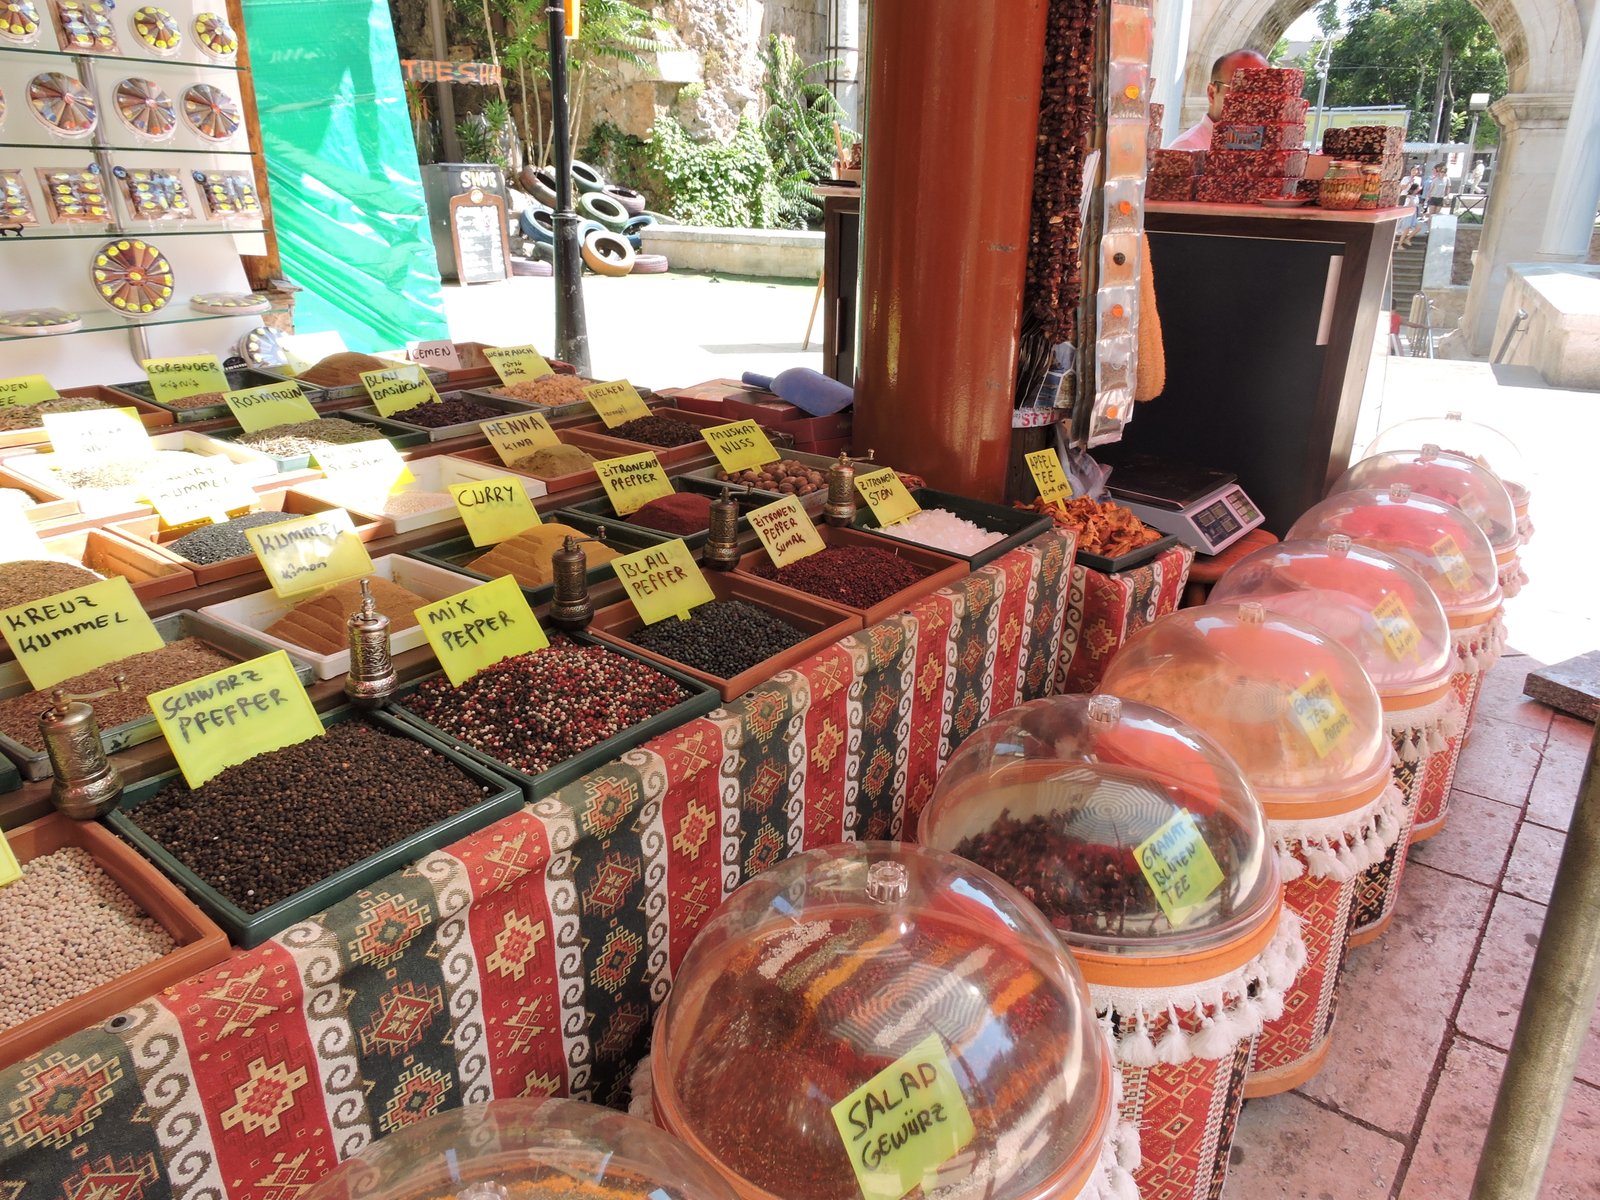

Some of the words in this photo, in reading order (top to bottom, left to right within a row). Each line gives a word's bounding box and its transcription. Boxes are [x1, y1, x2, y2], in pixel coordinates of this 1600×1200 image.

[365, 371, 399, 389] BLAU
[588, 384, 625, 400] NELKEN
[486, 415, 544, 437] HENNA
[710, 425, 756, 441] MUSKAT
[720, 438, 755, 455] NUSS
[1035, 470, 1055, 484] TEE
[458, 486, 513, 507] CURRY
[620, 552, 669, 578] BLAU
[6, 596, 98, 631] KREUZ
[441, 610, 516, 651] PEPPER
[162, 670, 263, 720] SCHWARZ
[1161, 875, 1190, 905] TEE
[848, 1062, 937, 1142] SALAD
[861, 1103, 947, 1171] GEWÜRZ
